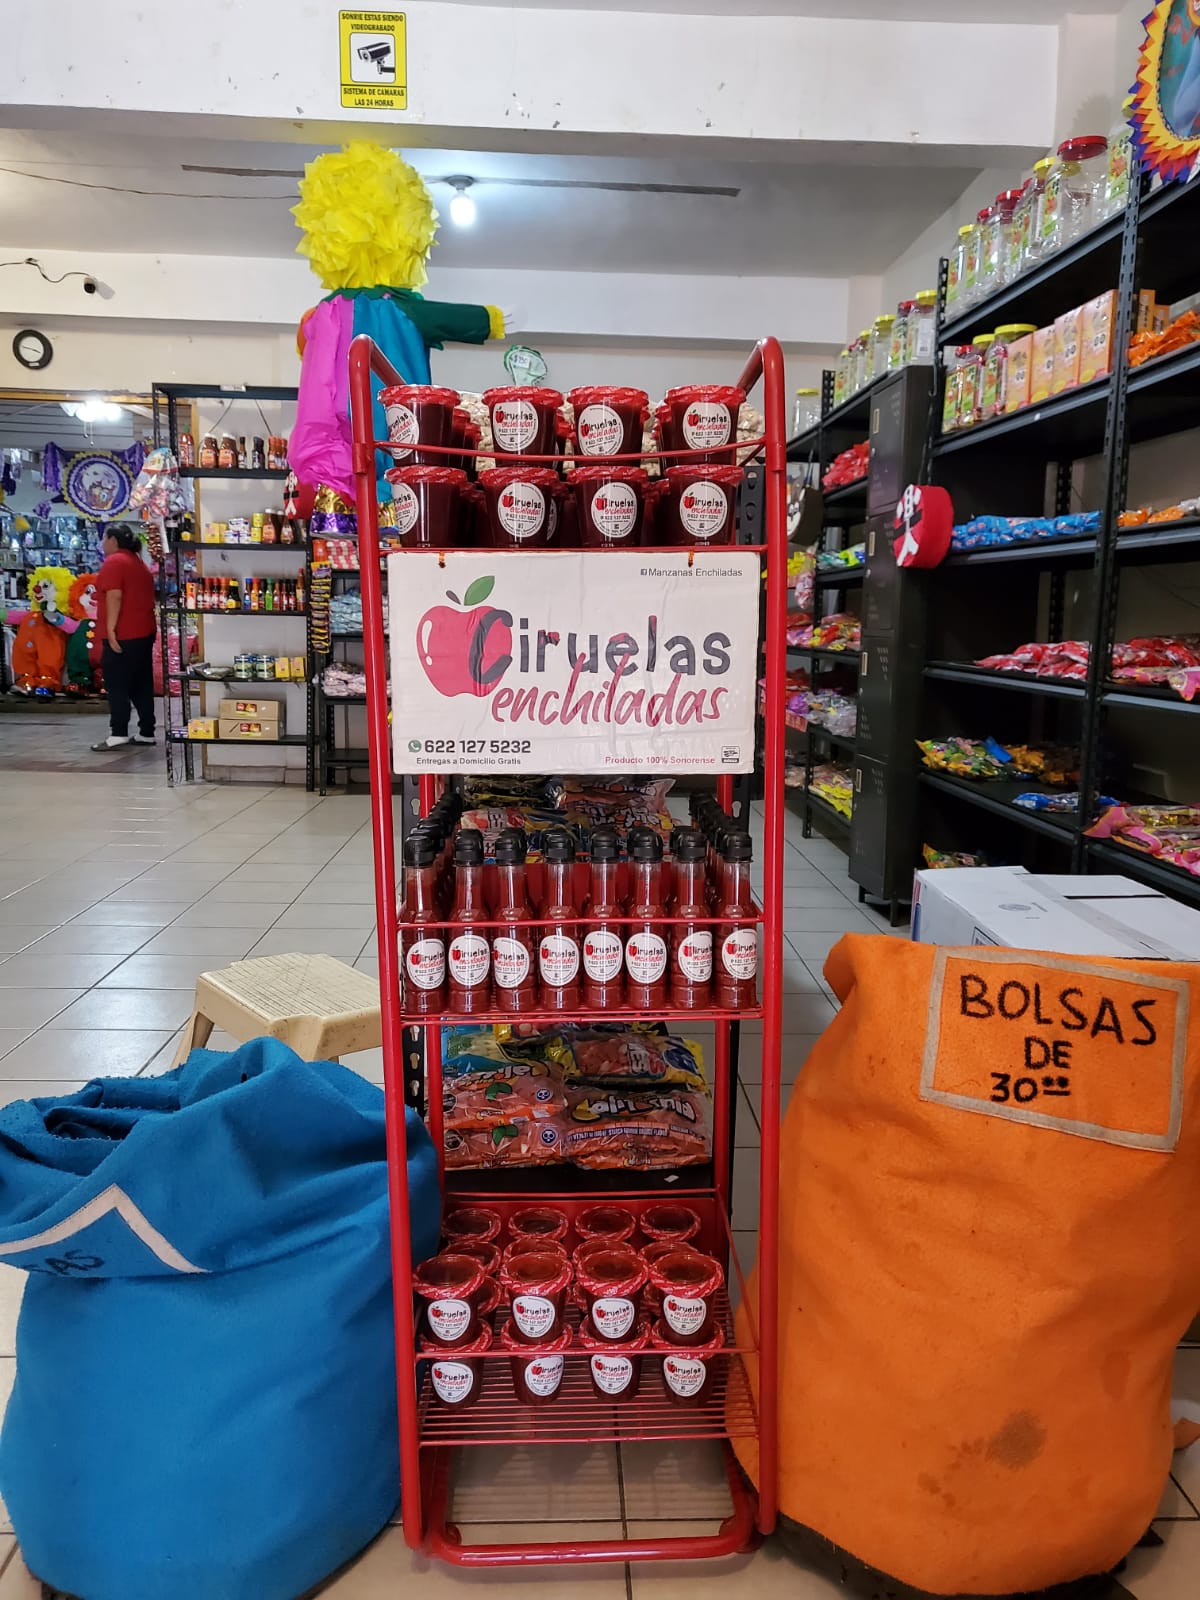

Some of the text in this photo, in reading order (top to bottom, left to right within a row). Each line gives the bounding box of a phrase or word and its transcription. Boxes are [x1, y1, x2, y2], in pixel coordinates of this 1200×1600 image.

[343, 88, 367, 96] SISTEMA
[368, 88, 376, 96] DE
[354, 98, 365, 106] LAS
[375, 99, 394, 107] HORAS
[648, 567, 743, 577] Manzanas Enchiladas
[468, 609, 732, 684] Ciruelas
[491, 652, 729, 727] enchiladas
[424, 740, 531, 754] 622 127 5232
[416, 757, 450, 766] Entregas
[459, 756, 494, 765] Domicilio
[496, 756, 521, 765] Gratis
[604, 756, 716, 765] Producto 100% Sonorense
[960, 973, 1157, 1046] BOLSAS
[1024, 1035, 1073, 1070] DE
